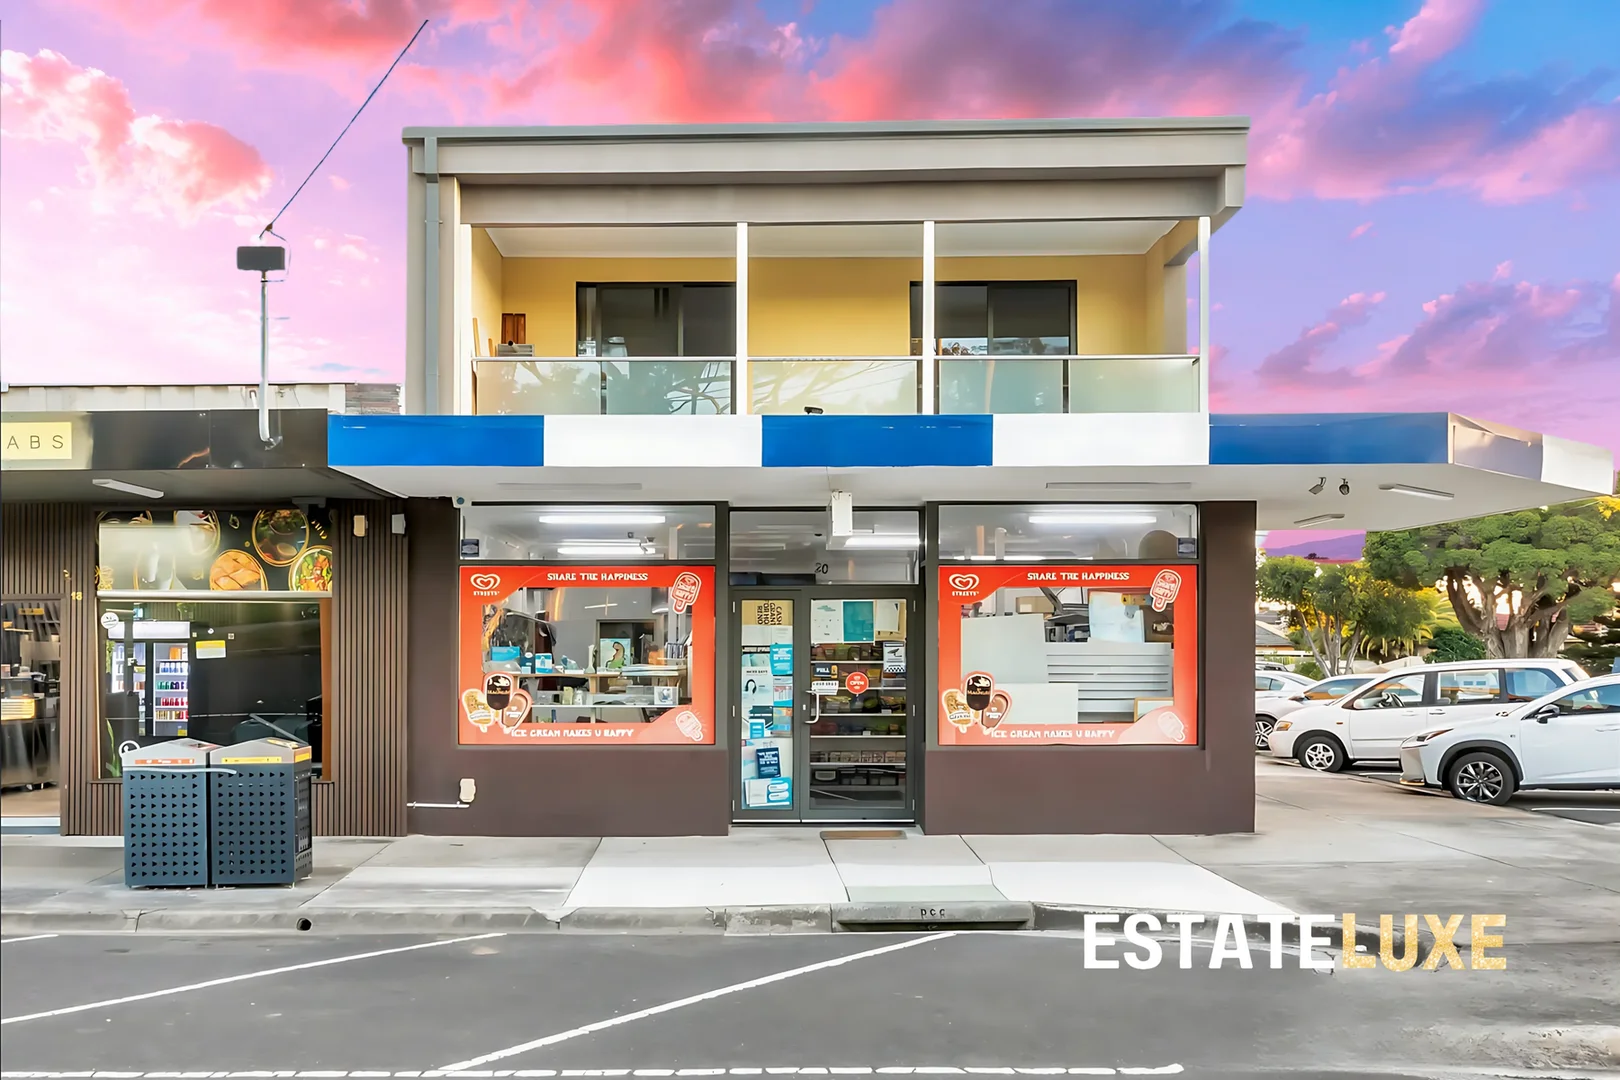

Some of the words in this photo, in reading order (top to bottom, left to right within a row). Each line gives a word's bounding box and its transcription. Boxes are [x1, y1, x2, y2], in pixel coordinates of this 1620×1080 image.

[814, 562, 829, 575] 20
[547, 572, 577, 581] SHARE
[579, 572, 598, 581] THE
[601, 572, 648, 581] HAPPINESS
[1027, 572, 1057, 580] SHARE
[1060, 572, 1079, 580] THE
[1082, 572, 1130, 580] HAPPINESS
[511, 729, 527, 737] ICE
[530, 729, 560, 737] CREAM
[563, 729, 592, 737] MAKES
[595, 729, 602, 737] U
[604, 729, 634, 737] HAPPY
[991, 730, 1007, 738] ICE
[1010, 730, 1041, 738] CREAM
[1044, 730, 1073, 738] MAKES
[1076, 730, 1083, 738] U
[1085, 730, 1115, 738] HAPPY
